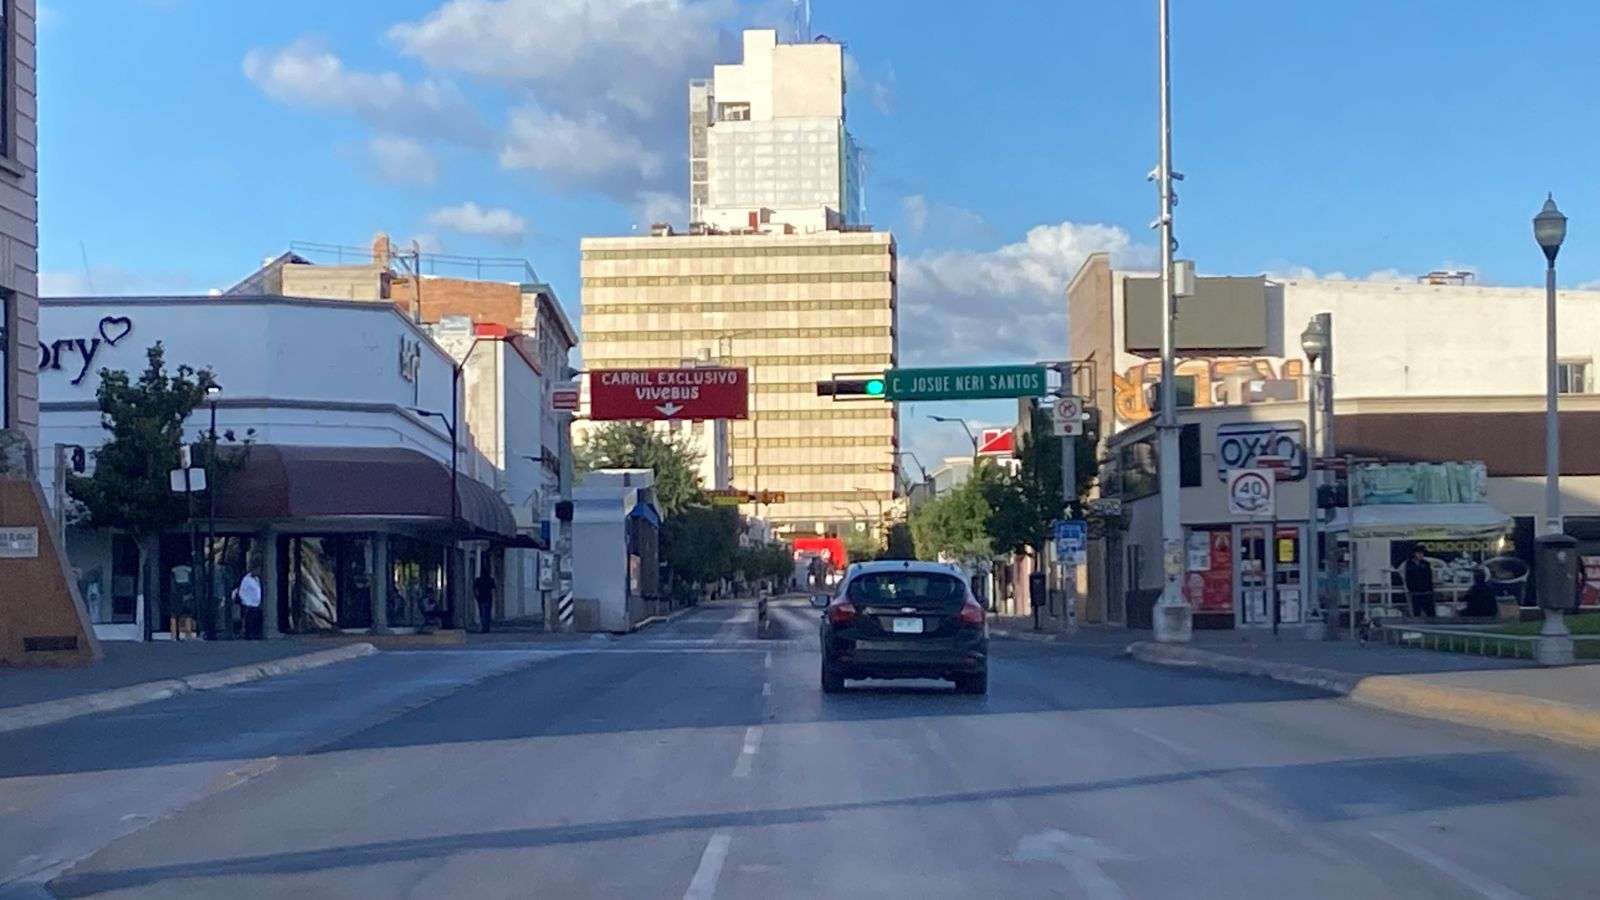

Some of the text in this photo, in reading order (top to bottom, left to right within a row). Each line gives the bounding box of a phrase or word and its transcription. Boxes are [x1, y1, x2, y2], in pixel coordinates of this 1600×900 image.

[601, 371, 738, 386] CARRIL EXCLUSIVO
[910, 376, 951, 393] JOSUE
[956, 375, 984, 391] NERI
[990, 373, 1039, 390] SANTOS
[1240, 481, 1262, 496] 40
